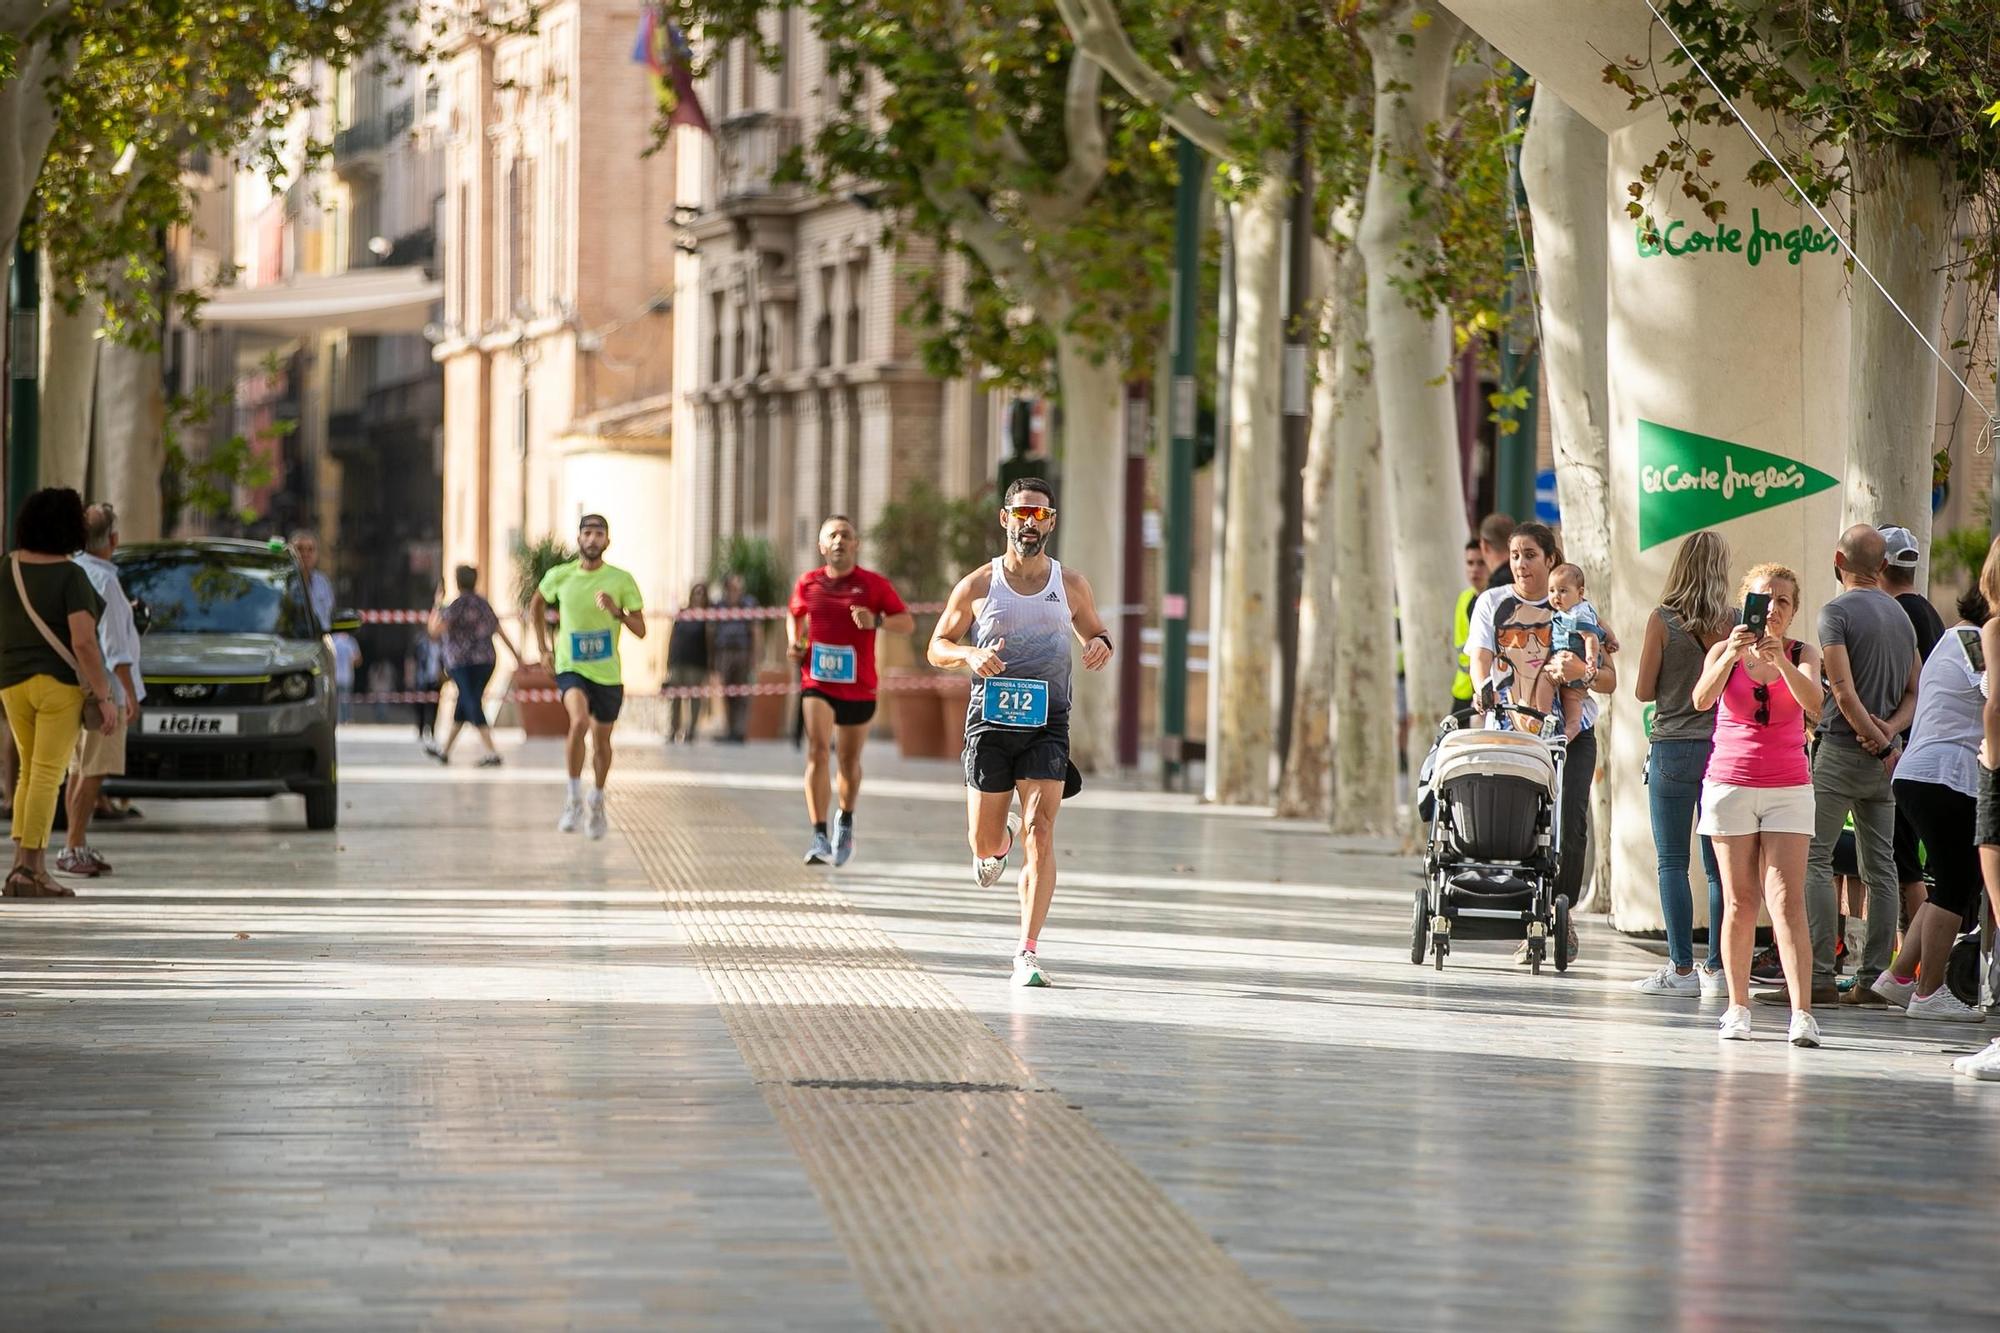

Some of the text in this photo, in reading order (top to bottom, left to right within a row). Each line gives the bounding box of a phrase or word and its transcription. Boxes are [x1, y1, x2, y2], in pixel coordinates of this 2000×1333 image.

[1664, 220, 1742, 256] Corte
[1747, 208, 1840, 266] Inglés
[1641, 455, 1805, 499] El Corte Inglés
[998, 691, 1033, 711] 212
